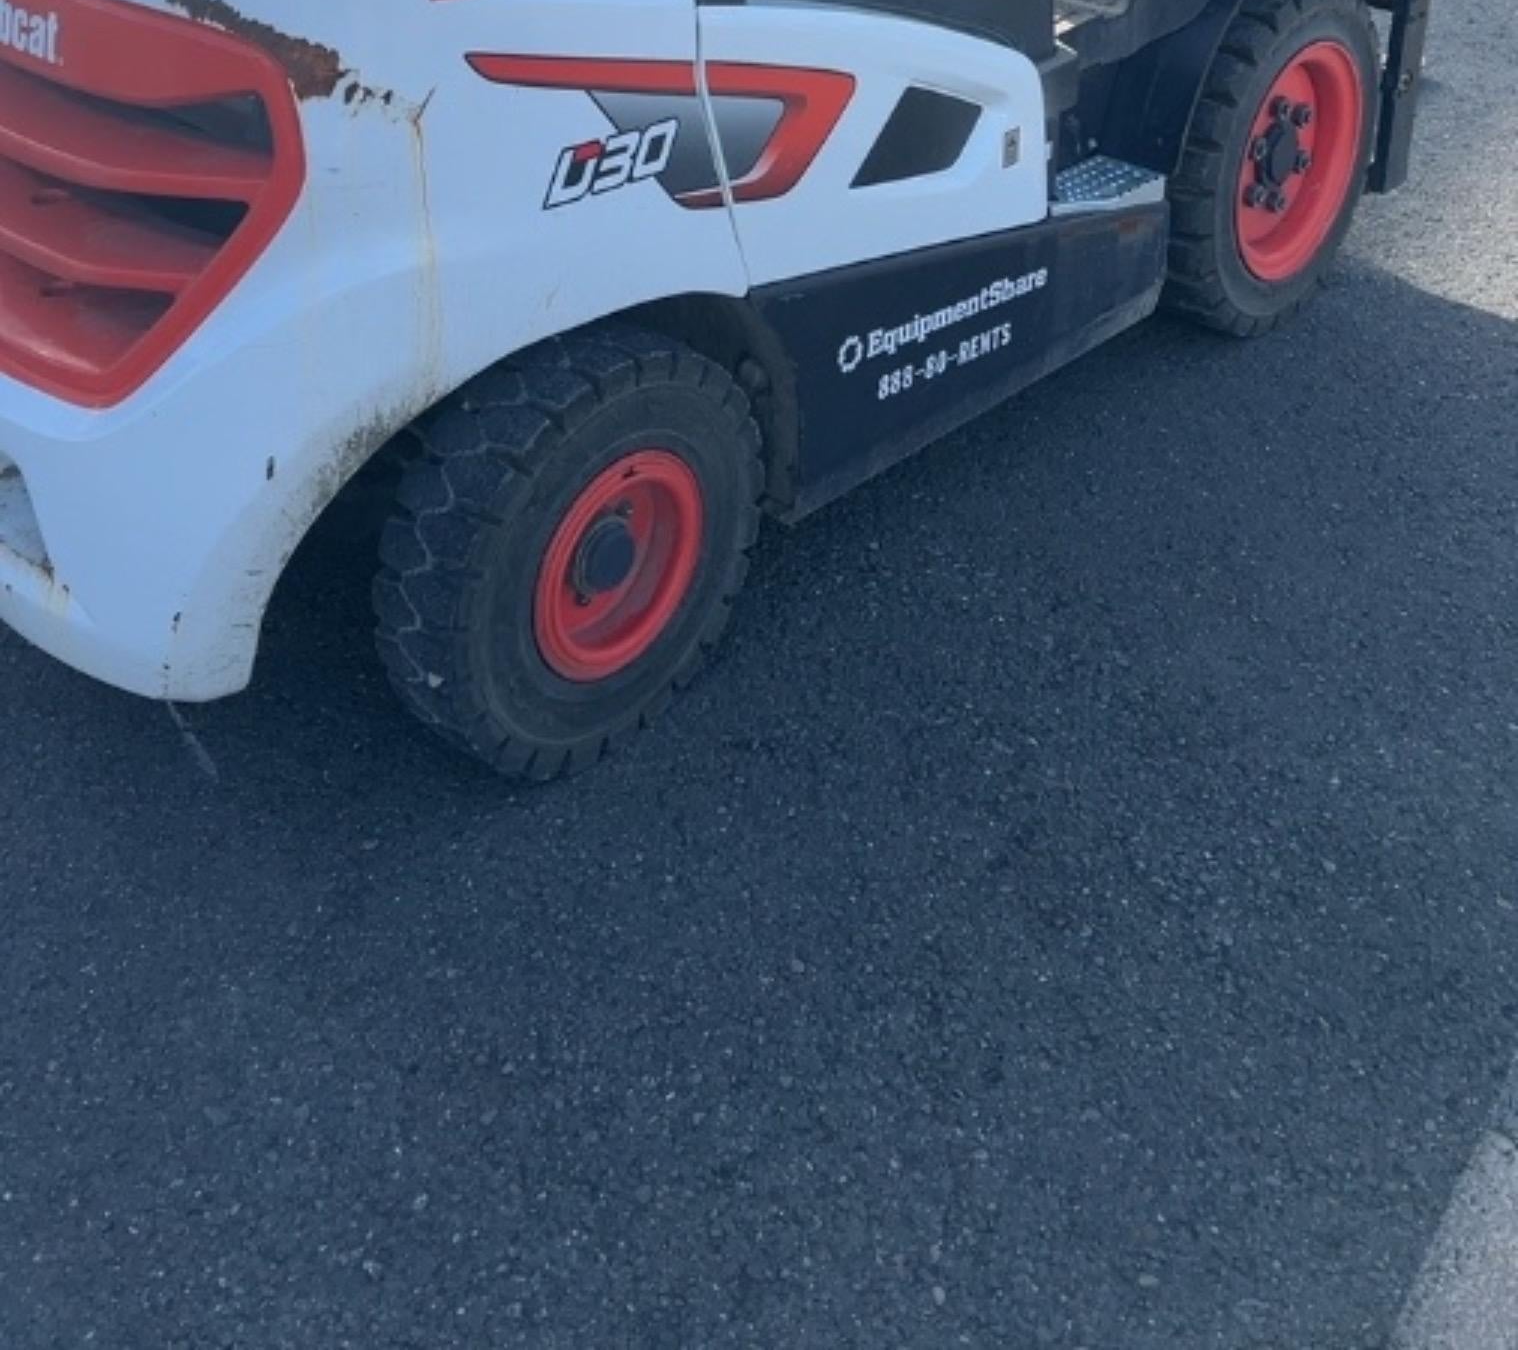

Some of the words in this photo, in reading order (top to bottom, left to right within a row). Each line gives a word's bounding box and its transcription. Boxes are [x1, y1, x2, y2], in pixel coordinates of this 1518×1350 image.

[543, 116, 680, 210] D30
[866, 266, 1049, 358] EquipmentShare
[878, 322, 1011, 400] 888-80-RENTS
